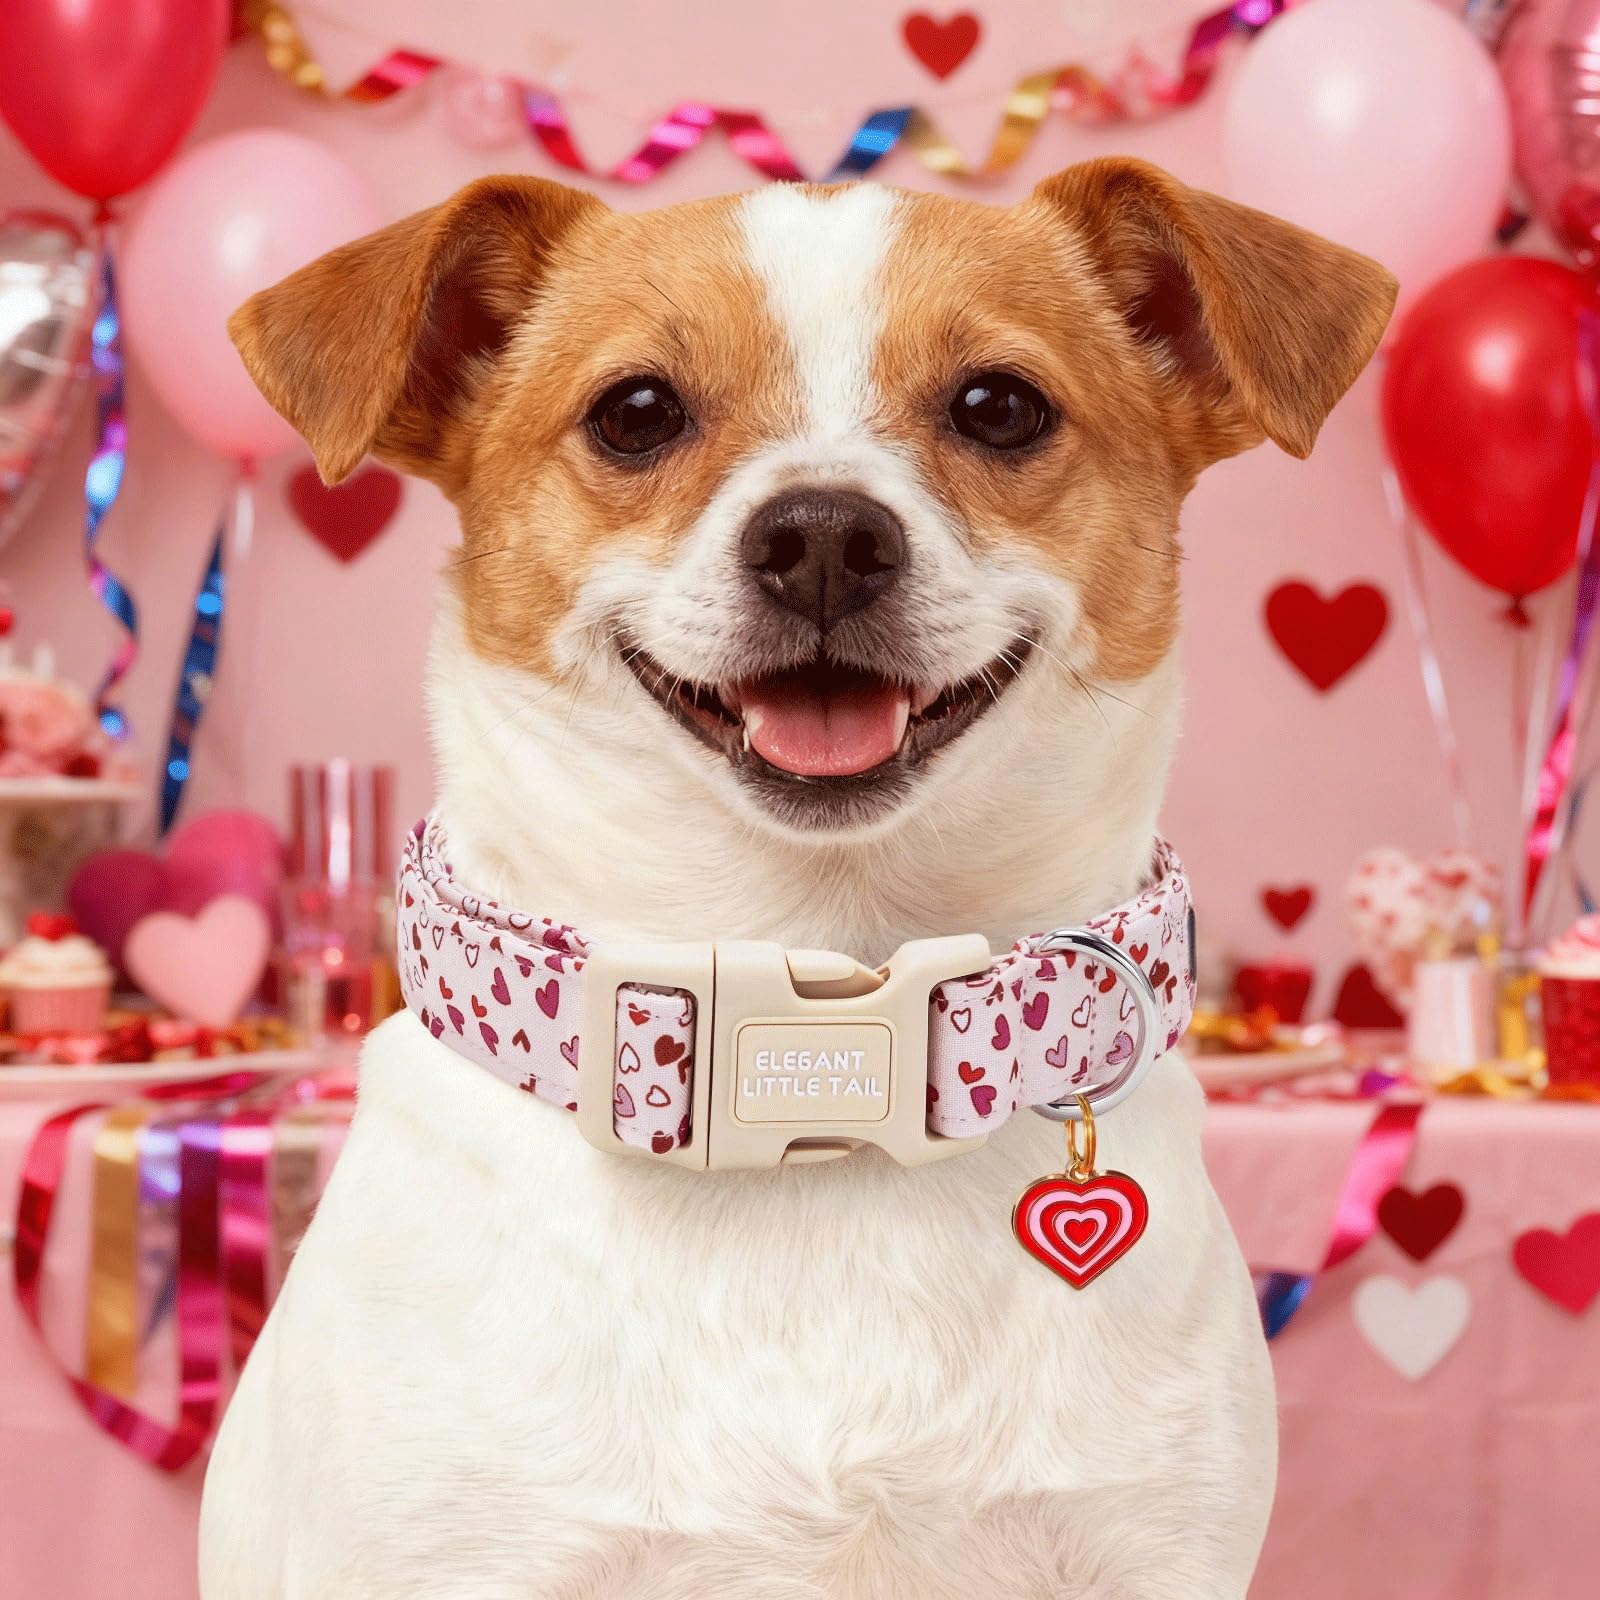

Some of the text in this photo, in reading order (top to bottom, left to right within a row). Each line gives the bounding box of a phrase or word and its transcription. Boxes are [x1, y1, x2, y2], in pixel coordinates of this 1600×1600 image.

[755, 1050, 865, 1071] ELEGANT
[742, 1076, 883, 1097] LITTLE TAIL
